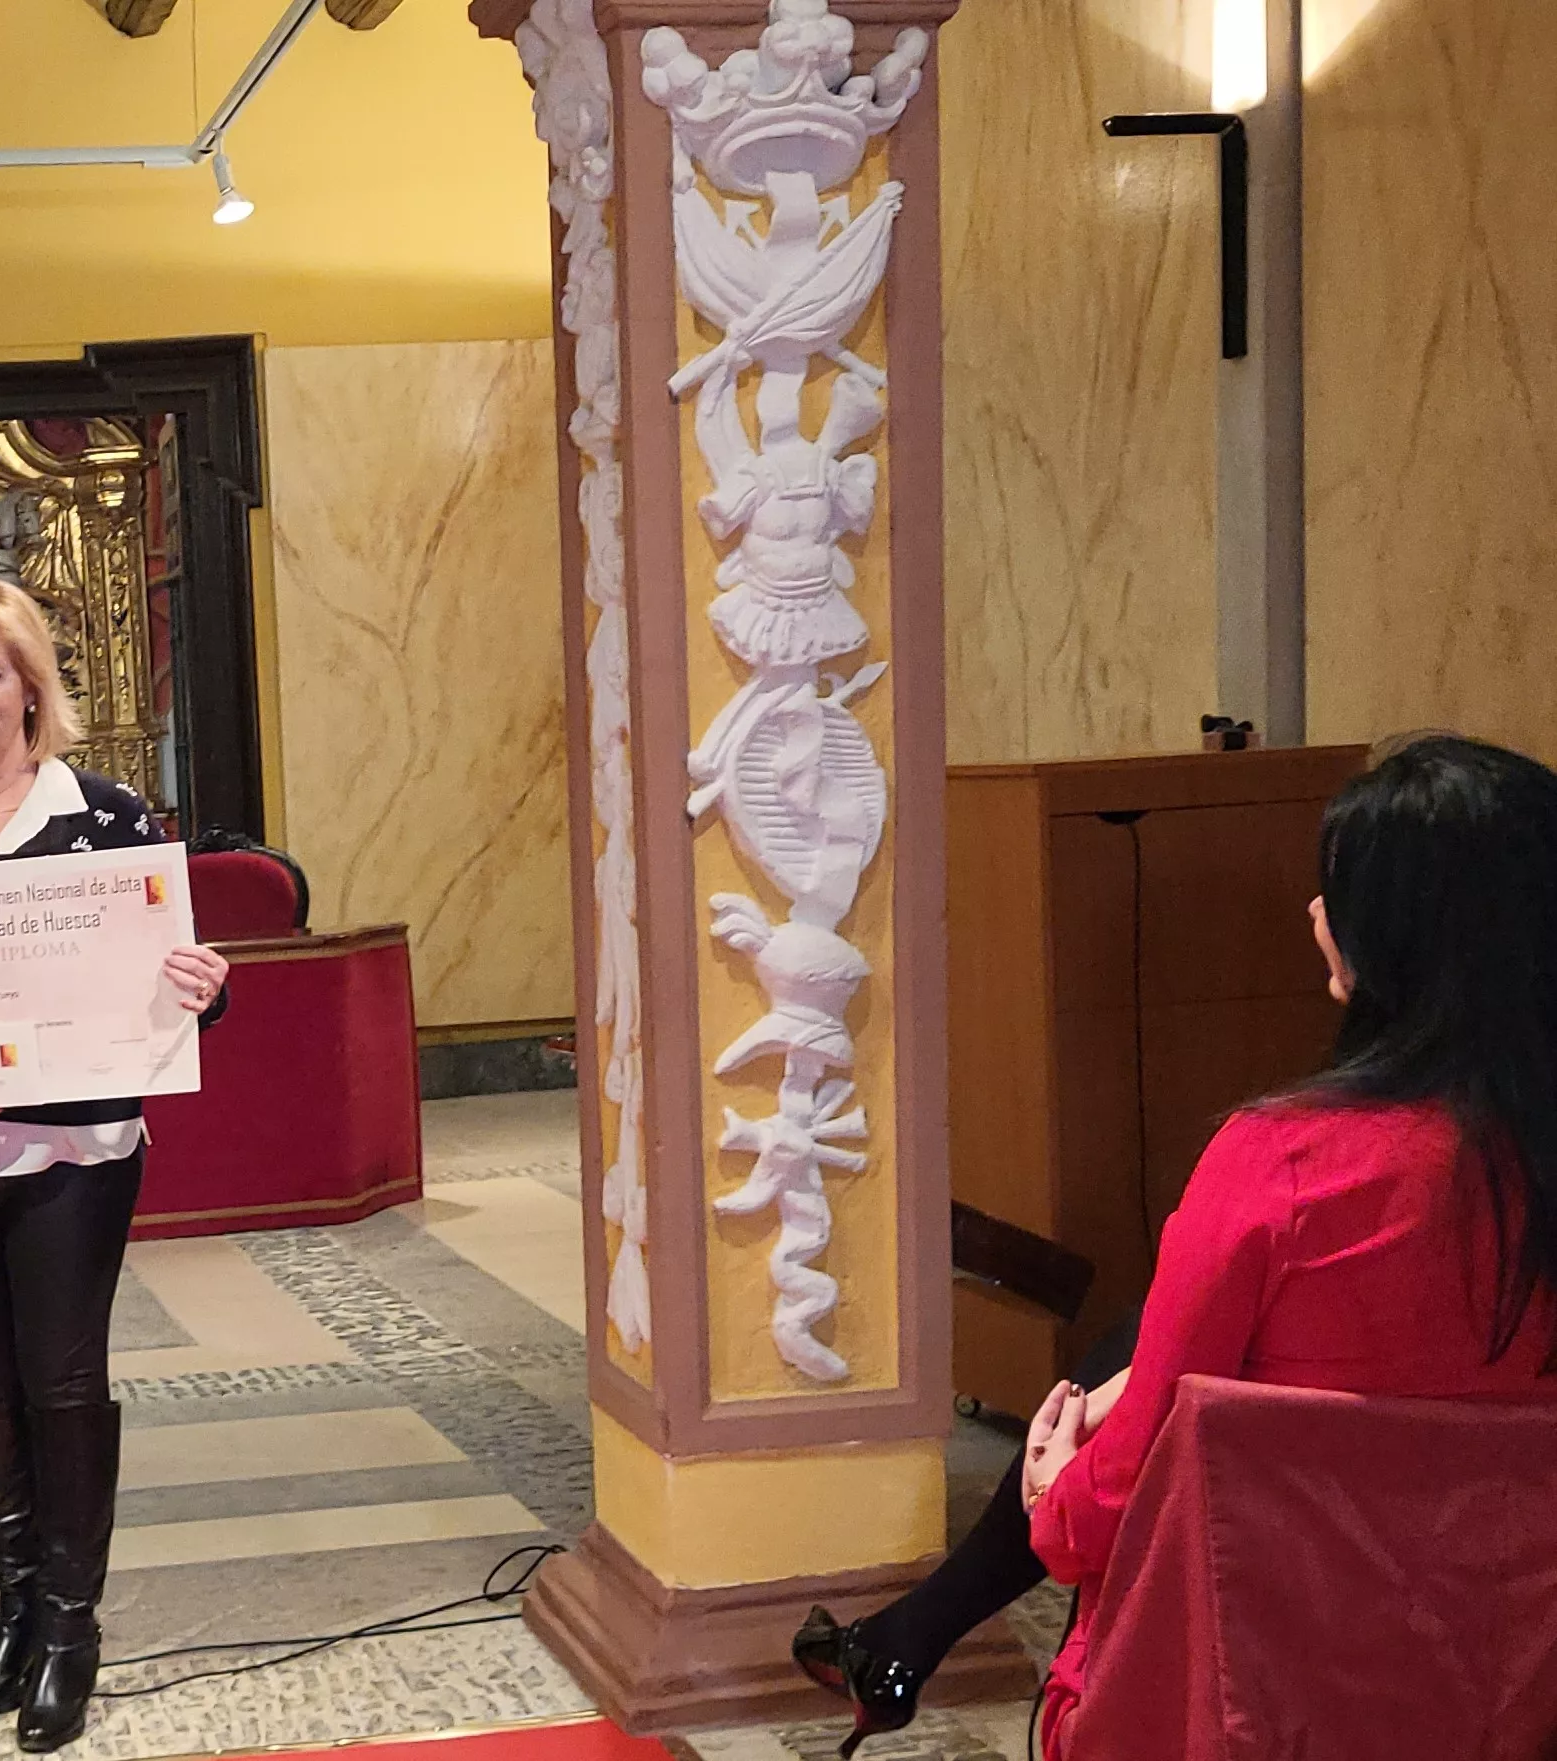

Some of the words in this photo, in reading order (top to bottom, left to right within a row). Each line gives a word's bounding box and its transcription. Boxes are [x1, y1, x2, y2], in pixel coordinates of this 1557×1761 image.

[26, 877, 87, 903] Nacional
[90, 876, 107, 896] de
[111, 873, 143, 895] Jota
[20, 913, 39, 934] de
